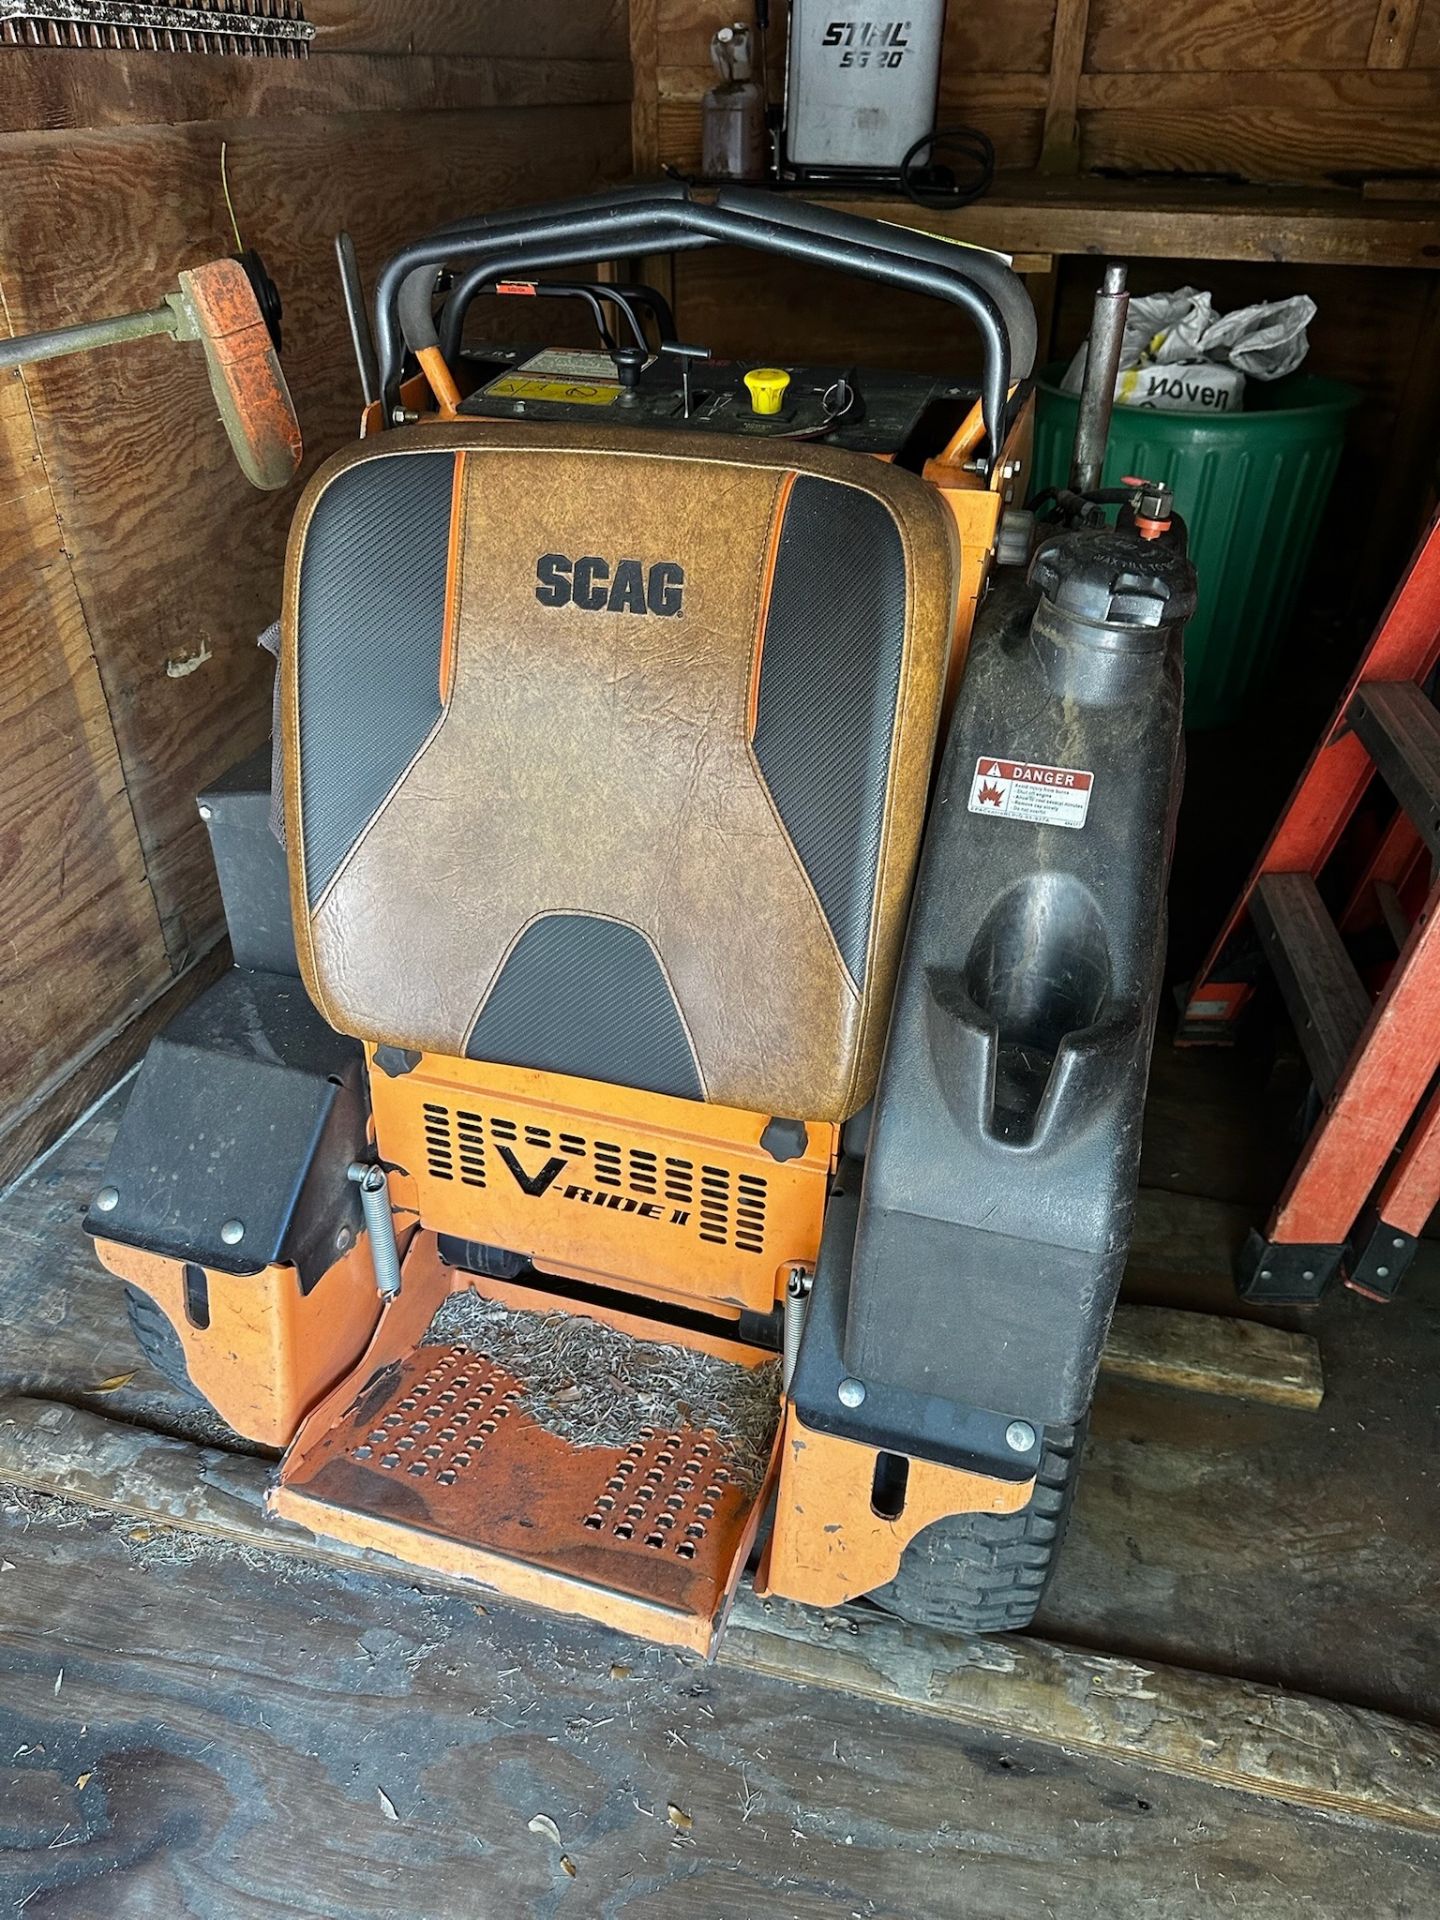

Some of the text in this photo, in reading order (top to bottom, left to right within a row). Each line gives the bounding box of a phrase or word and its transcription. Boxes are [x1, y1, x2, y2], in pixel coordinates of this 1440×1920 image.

[822, 22, 908, 46] STIHL
[876, 51, 904, 68] 20
[535, 553, 684, 617] SCAG
[1012, 766, 1074, 786] DANGER
